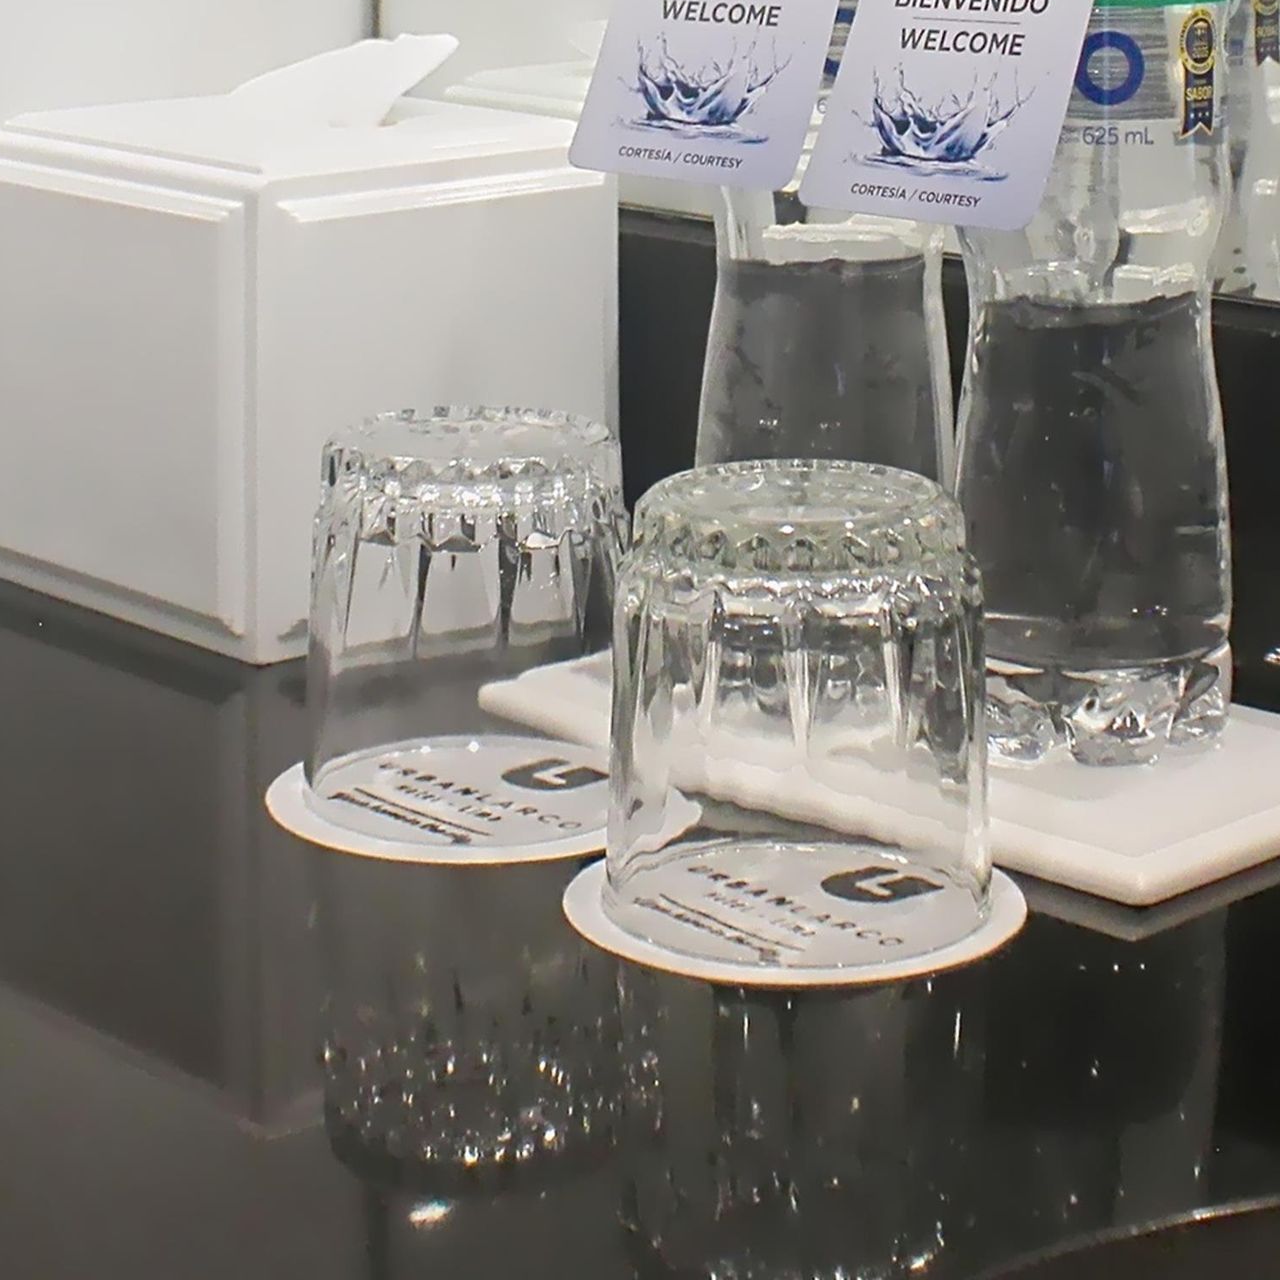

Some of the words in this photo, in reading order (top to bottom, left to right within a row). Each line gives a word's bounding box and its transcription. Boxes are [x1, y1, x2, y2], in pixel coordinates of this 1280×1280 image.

[661, 0, 782, 27] WELCOME
[900, 27, 1026, 57] WELCOME
[1082, 126, 1119, 145] 625
[1124, 126, 1155, 145] mL
[618, 145, 672, 162] CORTESÍA
[683, 153, 743, 169] COURTESY
[850, 183, 906, 200] CORTESÍA
[918, 191, 982, 208] COURTESY
